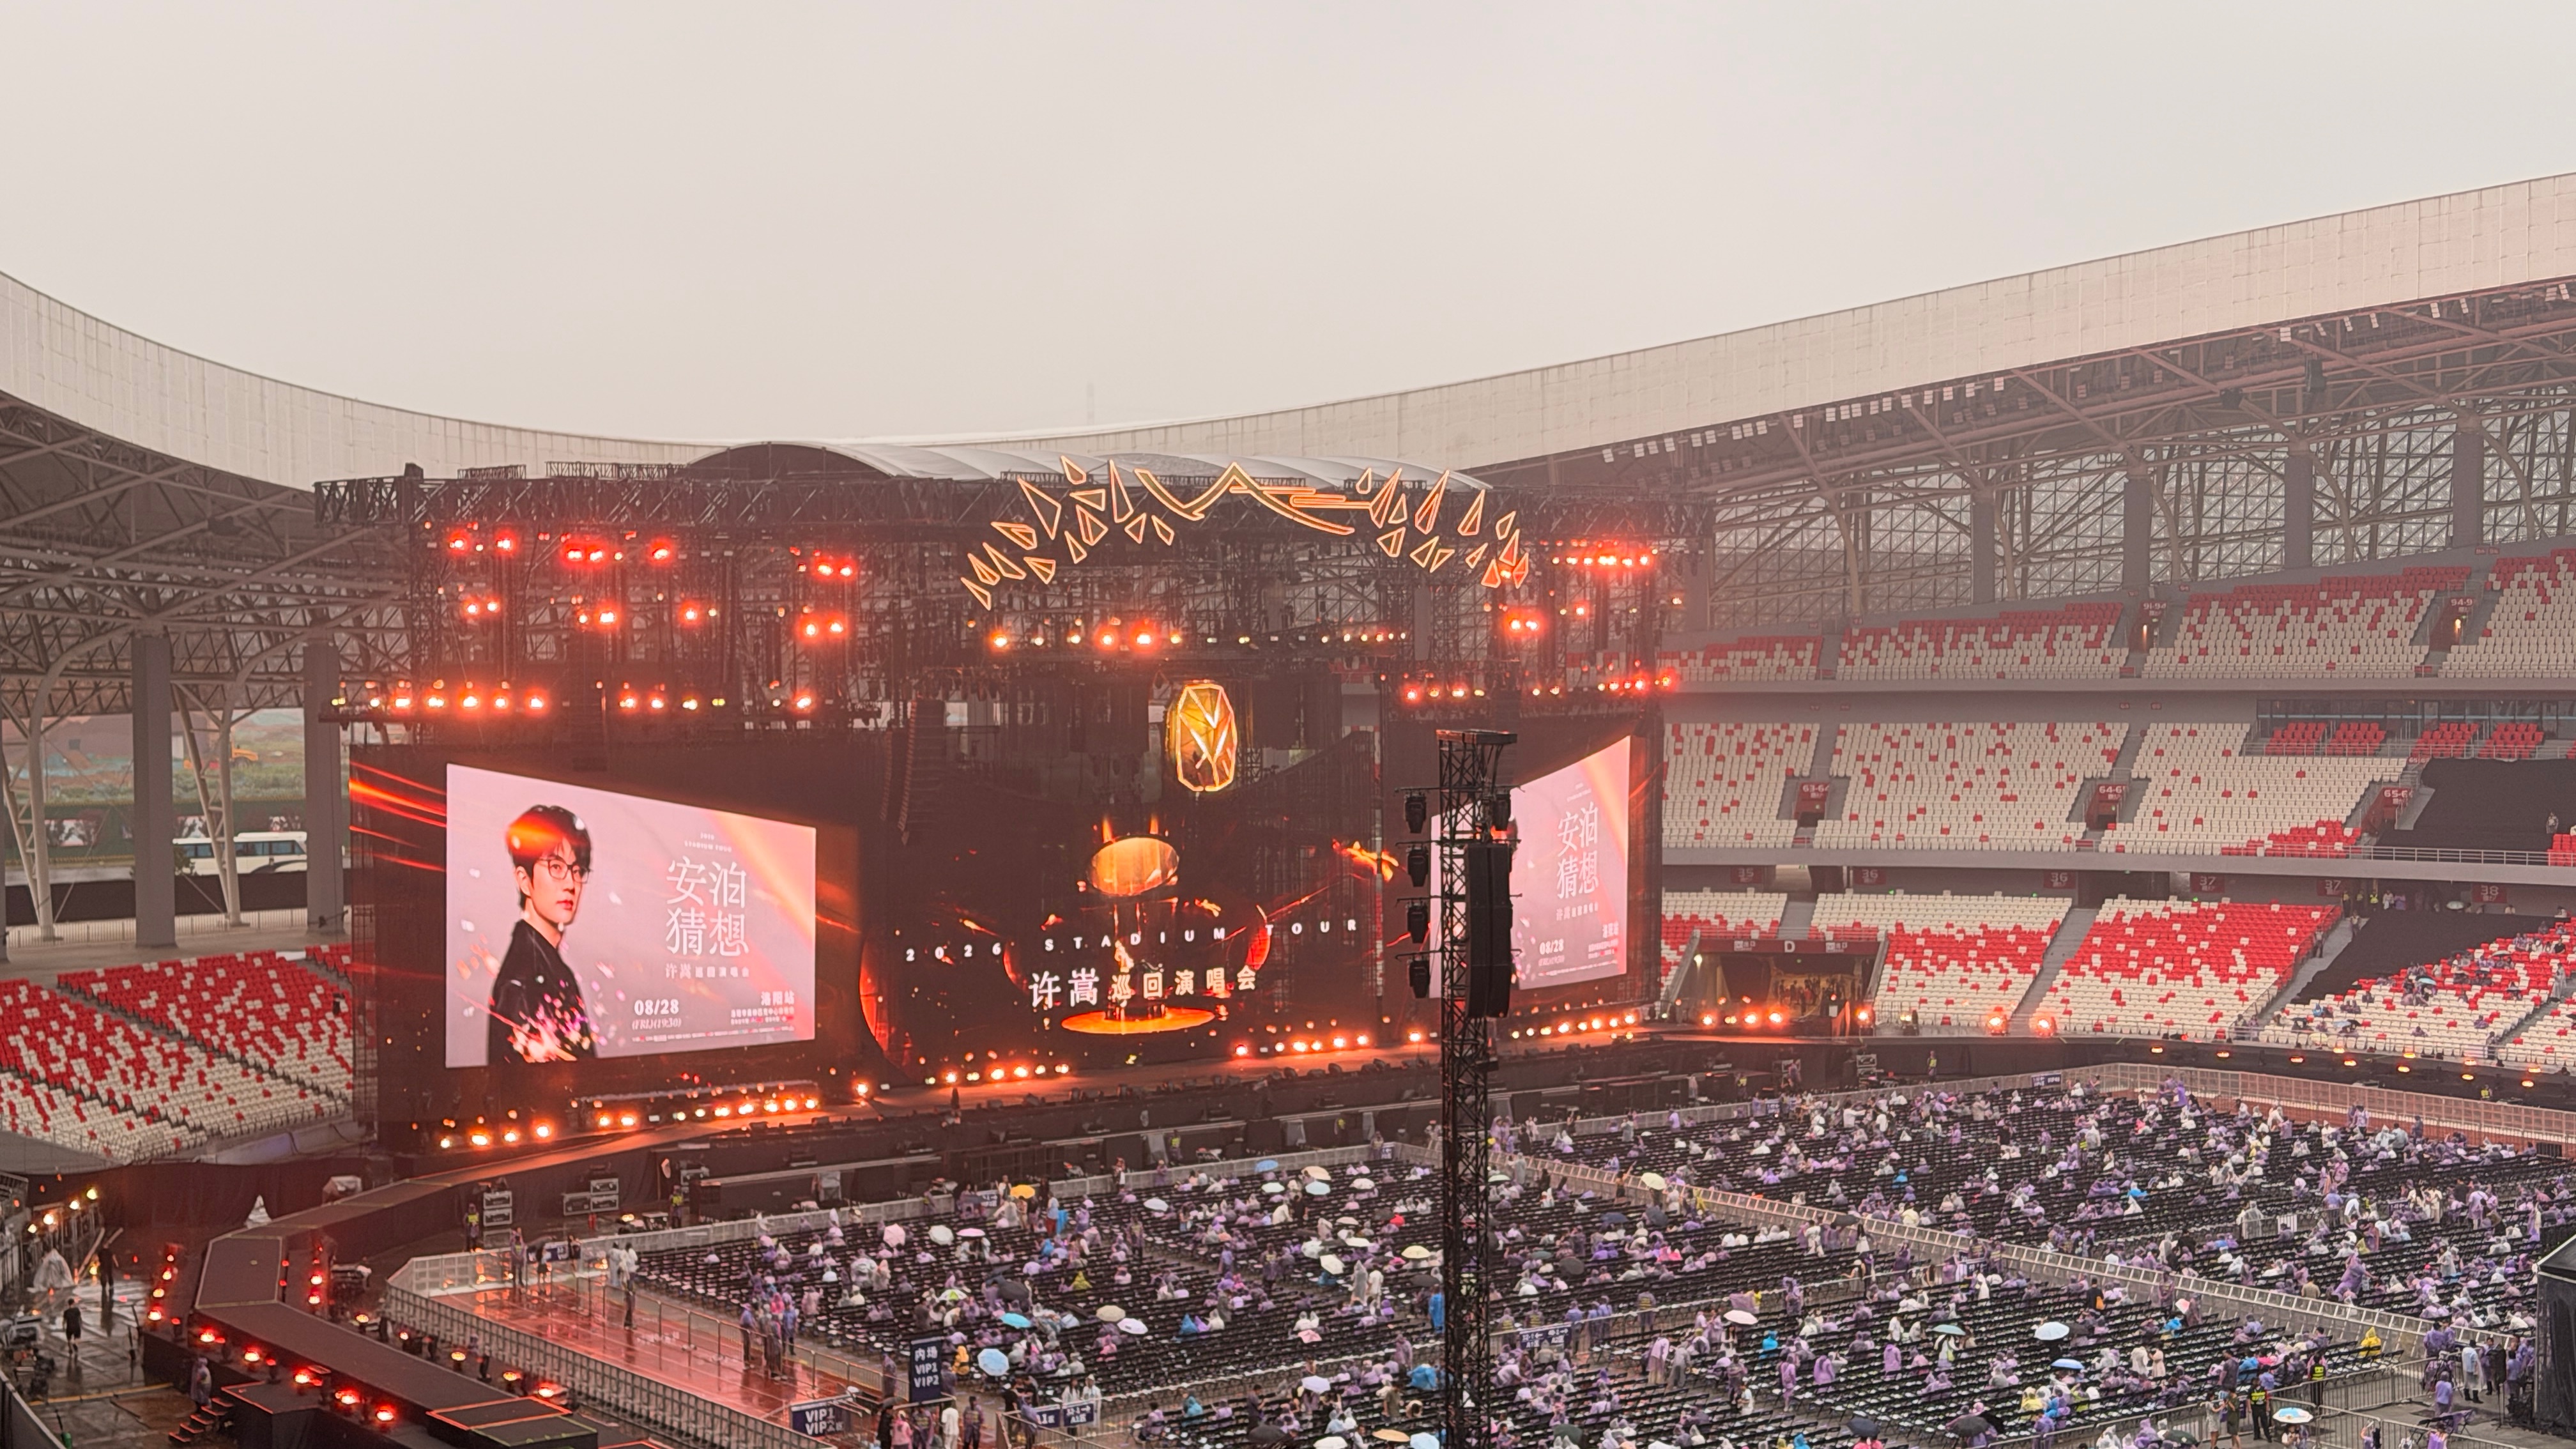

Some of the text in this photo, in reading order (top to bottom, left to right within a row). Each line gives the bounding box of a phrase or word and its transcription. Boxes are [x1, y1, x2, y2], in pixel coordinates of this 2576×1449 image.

[2451, 598, 2472, 606] 94-9
[1557, 801, 1598, 857] 安泊
[1556, 850, 1599, 899] 猜想
[1862, 869, 1878, 878] 36
[2050, 872, 2068, 882] 36
[2199, 875, 2217, 885] 37
[666, 855, 746, 908] 安泊
[2325, 879, 2342, 891] 37
[2480, 885, 2499, 896] 38
[666, 907, 749, 956] 猜想
[906, 919, 1356, 962] 2026 STADIUM TOUR
[1784, 940, 1795, 953] D
[1029, 965, 1256, 1008] 许嵩巡回演唱会
[634, 999, 679, 1015] 08/28
[915, 1346, 938, 1361] 内场
[915, 1362, 938, 1375] VIP1
[914, 1375, 939, 1388] VIP2
[805, 1407, 835, 1423] VIP1
